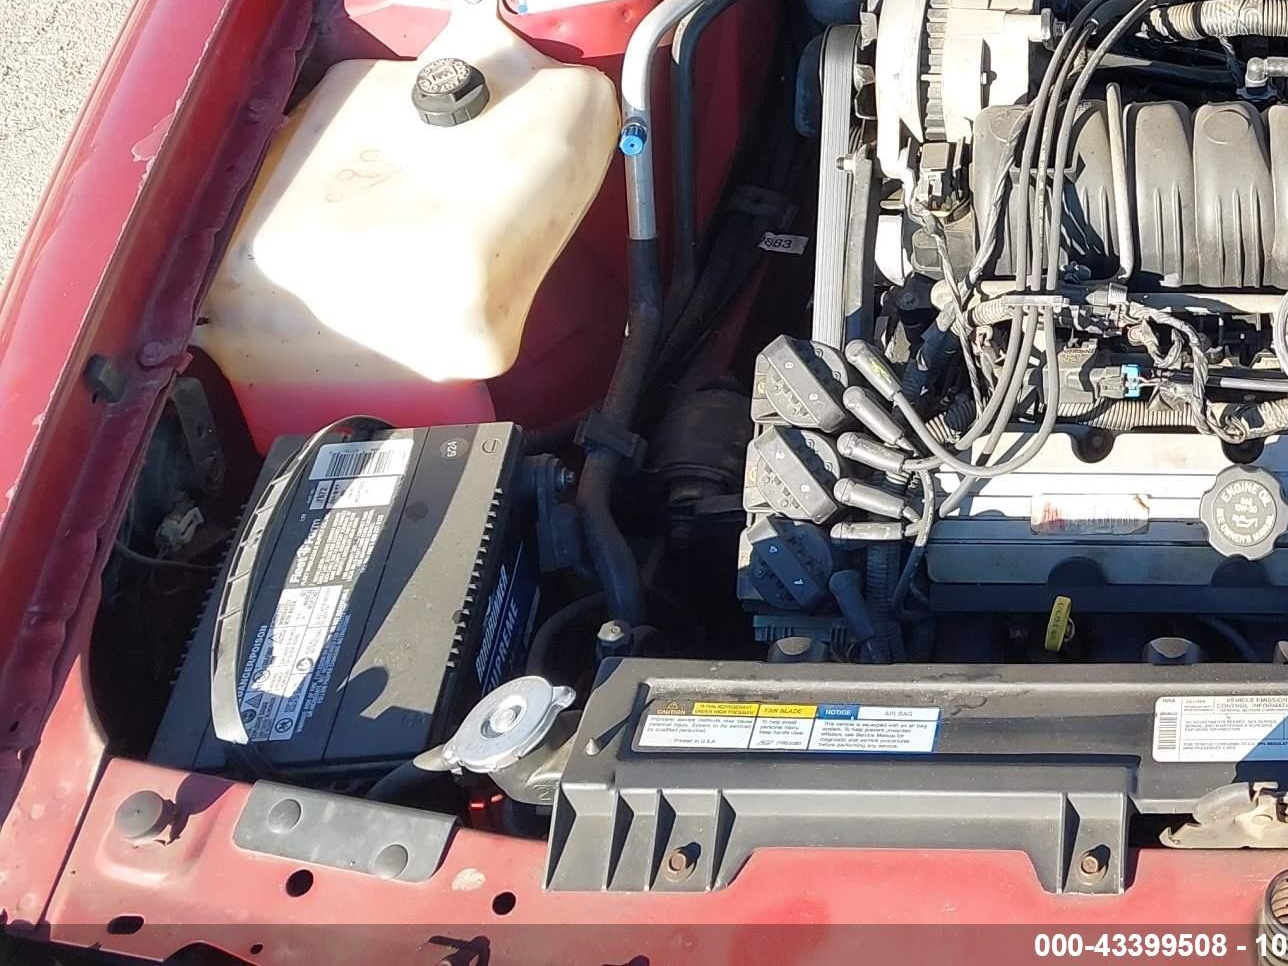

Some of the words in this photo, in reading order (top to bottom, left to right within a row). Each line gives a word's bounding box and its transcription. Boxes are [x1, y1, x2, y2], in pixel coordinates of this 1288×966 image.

[1221, 482, 1260, 502] ENGINE
[1259, 489, 1273, 507] OIL
[1252, 514, 1275, 541] MANUAL
[289, 556, 308, 583] Fleet
[304, 518, 321, 544] Farm
[769, 545, 778, 554] 4
